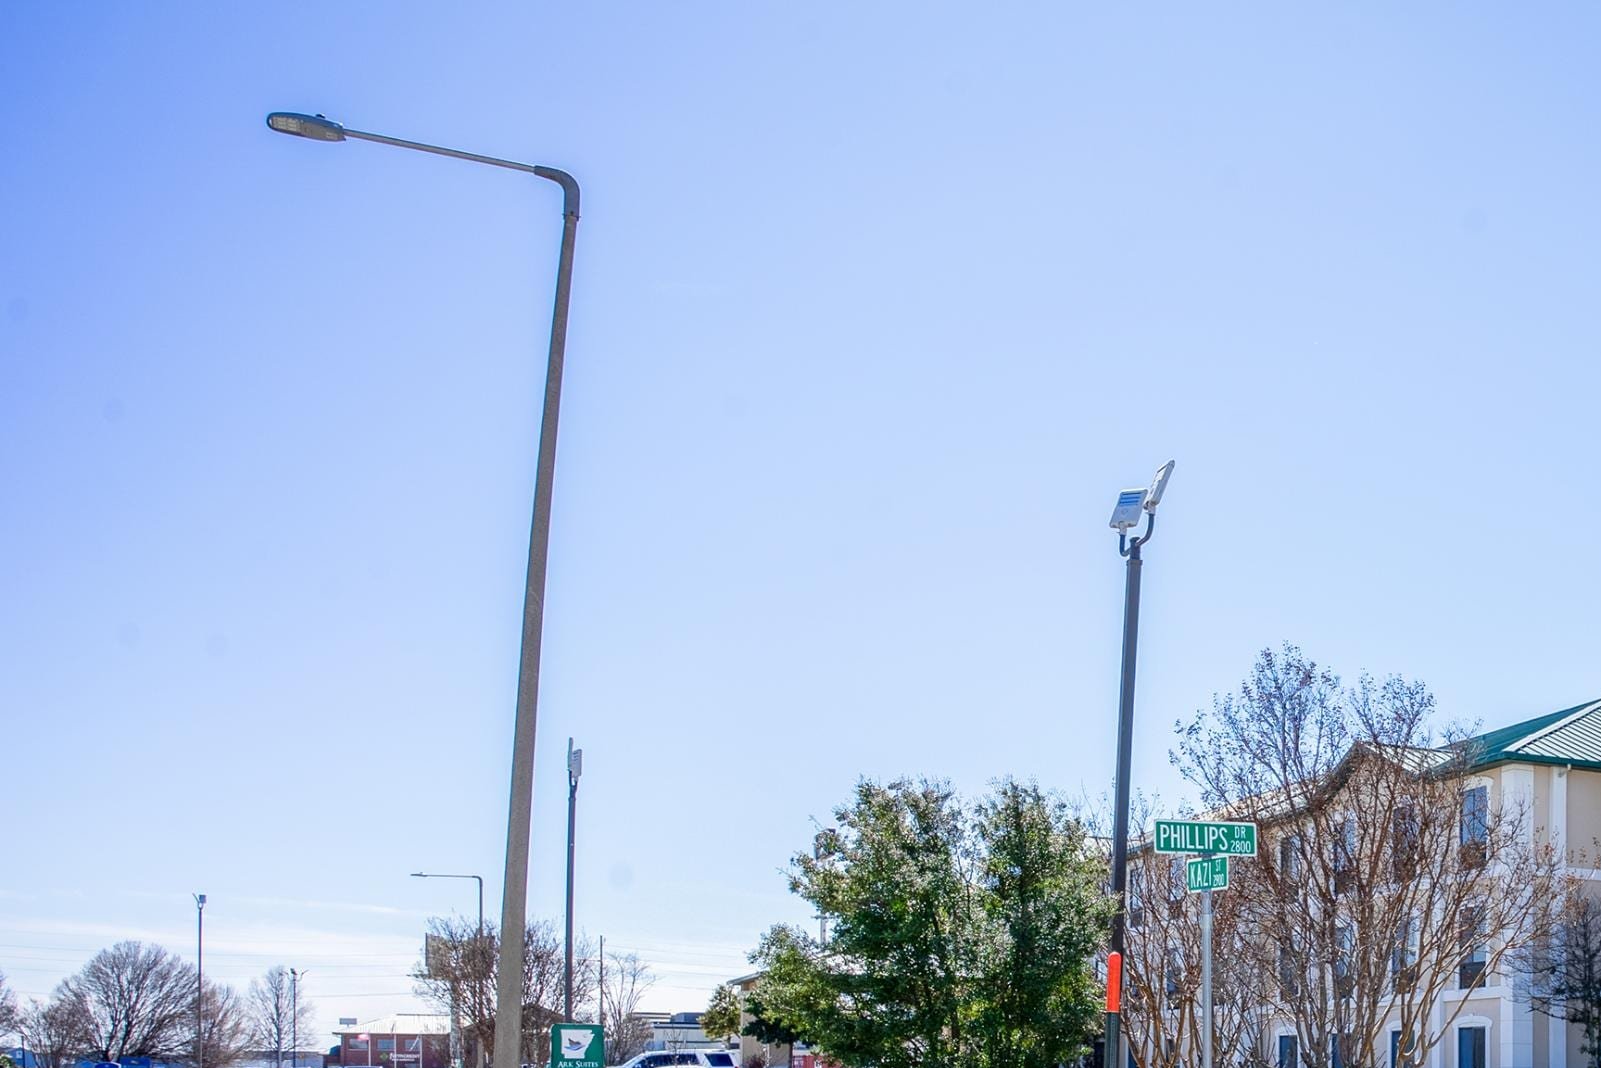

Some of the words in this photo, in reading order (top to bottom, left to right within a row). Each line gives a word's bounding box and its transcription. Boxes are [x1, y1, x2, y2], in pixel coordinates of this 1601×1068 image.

[1160, 824, 1228, 851] PHILLIPS
[1234, 826, 1246, 839] DR
[1230, 840, 1251, 853] 2800
[1190, 861, 1212, 888] KAZI
[1215, 859, 1221, 872] ST
[557, 1060, 574, 1068] ARK
